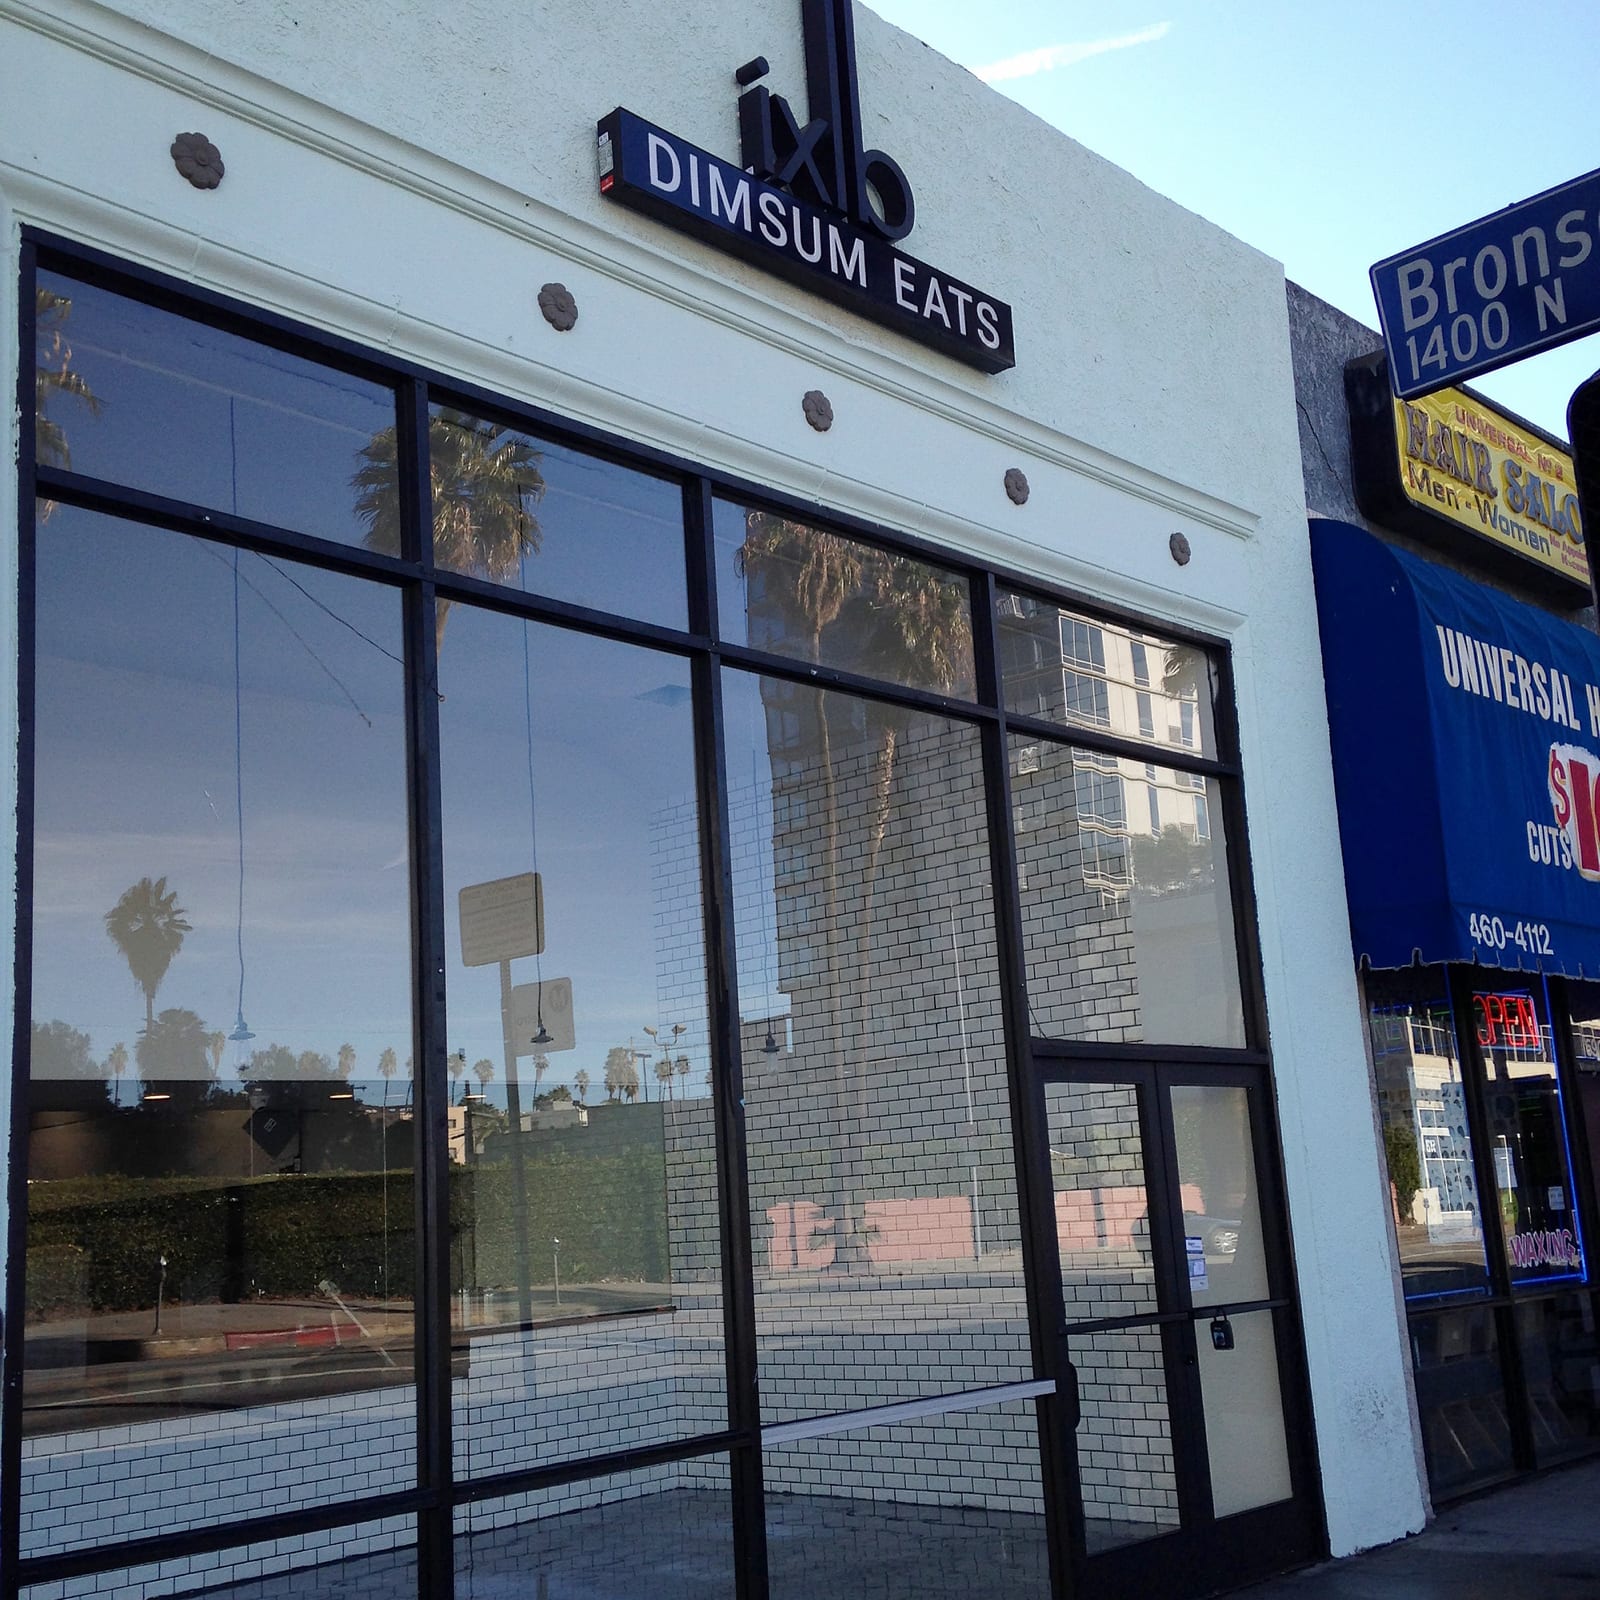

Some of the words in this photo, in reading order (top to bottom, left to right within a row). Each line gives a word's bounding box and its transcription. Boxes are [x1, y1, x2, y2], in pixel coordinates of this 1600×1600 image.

[647, 131, 868, 289] DIMSUM
[893, 257, 1001, 350] EATS
[1397, 209, 1600, 333] Brons
[1406, 301, 1510, 381] 1400
[1534, 276, 1567, 332] N
[1403, 402, 1498, 499] HAIR
[1455, 405, 1533, 464] UNIVERSAL
[1407, 460, 1460, 511] Men
[1474, 494, 1551, 557] Women
[1435, 624, 1581, 731] UNIVERSAL
[1526, 820, 1573, 871] CUTS
[1551, 748, 1600, 872] $1
[1469, 912, 1554, 956] 460-4112
[1509, 1228, 1576, 1269] WAXING
